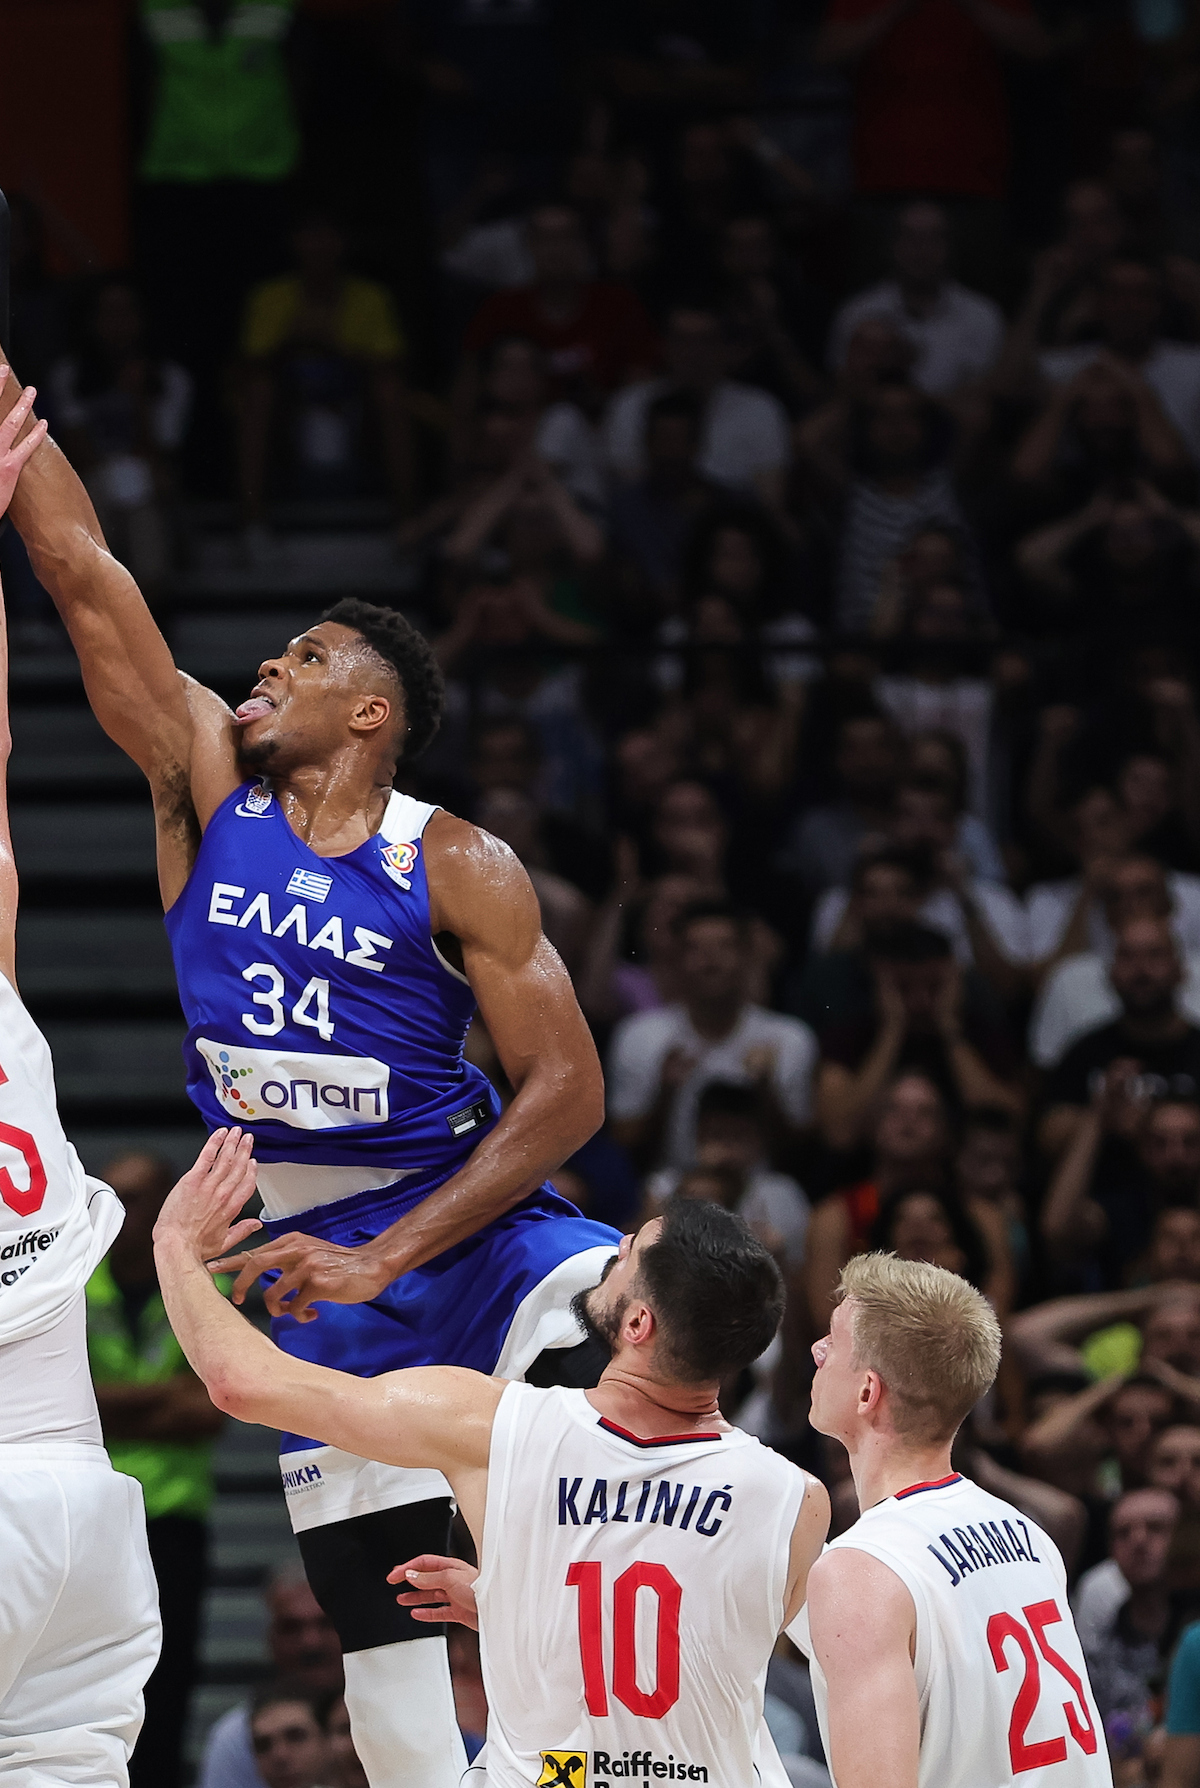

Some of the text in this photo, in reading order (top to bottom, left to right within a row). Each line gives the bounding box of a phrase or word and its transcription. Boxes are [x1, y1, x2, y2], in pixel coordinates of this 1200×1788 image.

[241, 962, 334, 1042] 34
[478, 1108, 486, 1118] L
[558, 1477, 734, 1537] KALINIĆ
[926, 1519, 1041, 1587] JARAMAZ
[565, 1561, 682, 1720] 10
[986, 1598, 1097, 1776] 25
[593, 1750, 708, 1783] Raiffeisen
